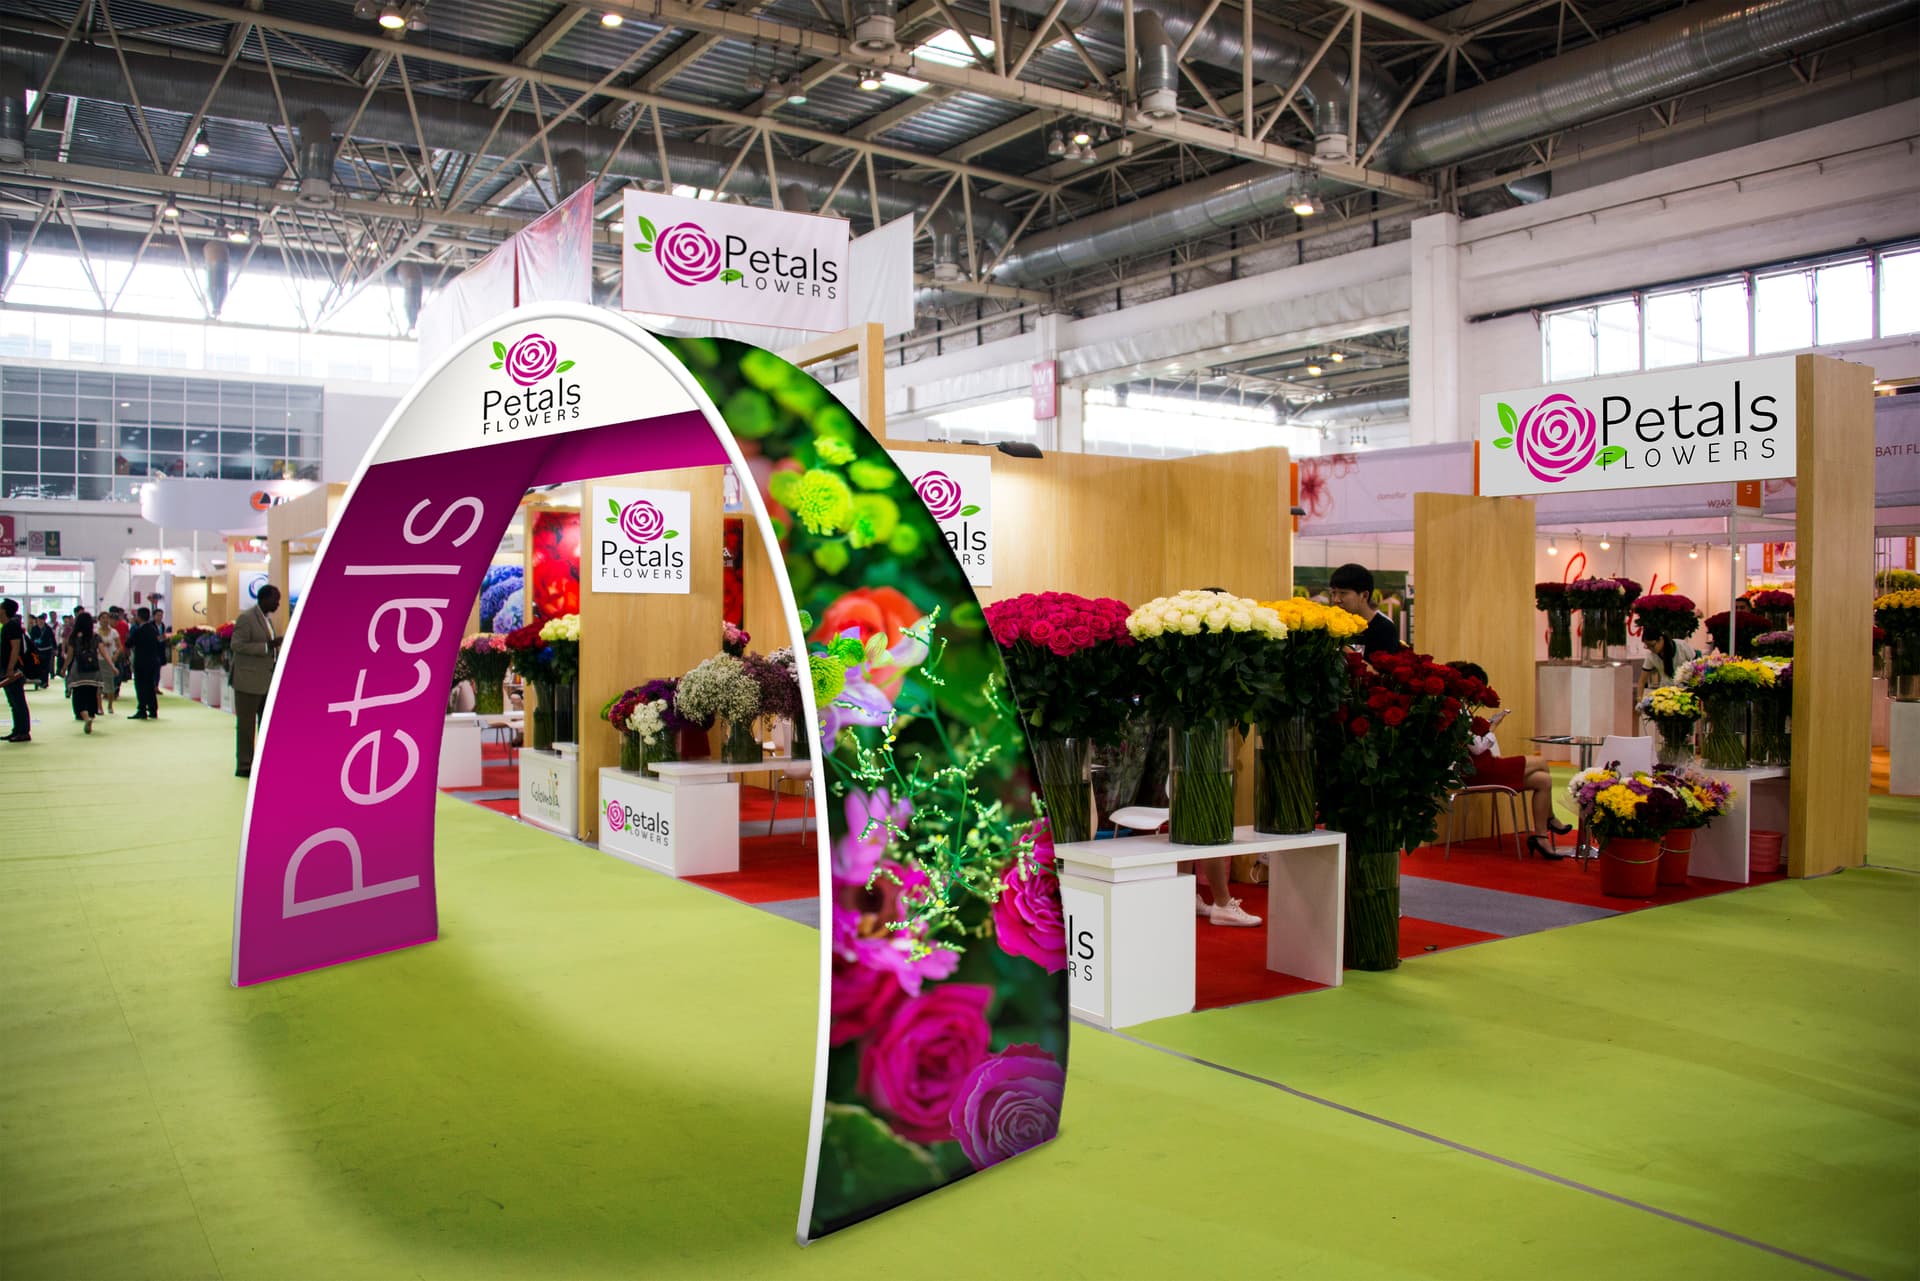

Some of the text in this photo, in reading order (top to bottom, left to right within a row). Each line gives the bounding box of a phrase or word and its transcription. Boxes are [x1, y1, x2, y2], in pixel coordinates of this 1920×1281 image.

[724, 234, 838, 284] Petals
[724, 272, 837, 300] FLOWERS
[482, 377, 582, 421] Petals
[1602, 380, 1778, 447] Petals
[482, 406, 581, 435] FLOWERS
[1602, 437, 1776, 472] FLOWERS
[945, 521, 987, 551] als
[600, 540, 684, 569] Petals
[600, 567, 683, 580] FLOWERS
[282, 495, 486, 919] Petals
[624, 804, 670, 836] Petals
[629, 829, 669, 847] LOWERS
